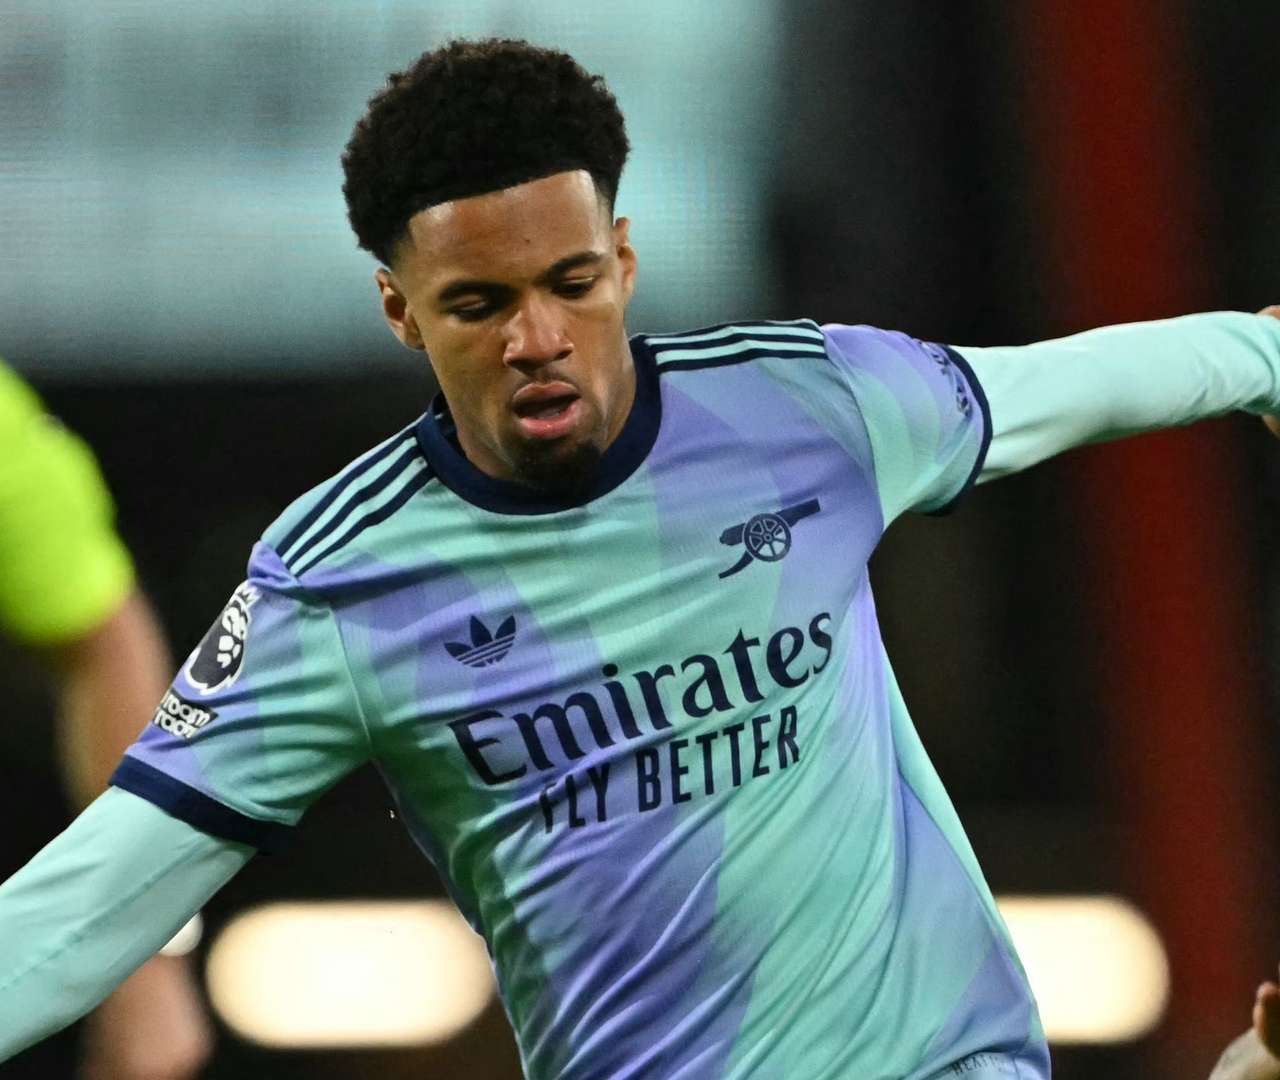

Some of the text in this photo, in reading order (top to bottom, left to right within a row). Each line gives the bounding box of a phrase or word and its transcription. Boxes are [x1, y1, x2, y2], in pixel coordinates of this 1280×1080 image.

[446, 611, 833, 786] Emirates
[539, 704, 800, 834] FLY BETTER
